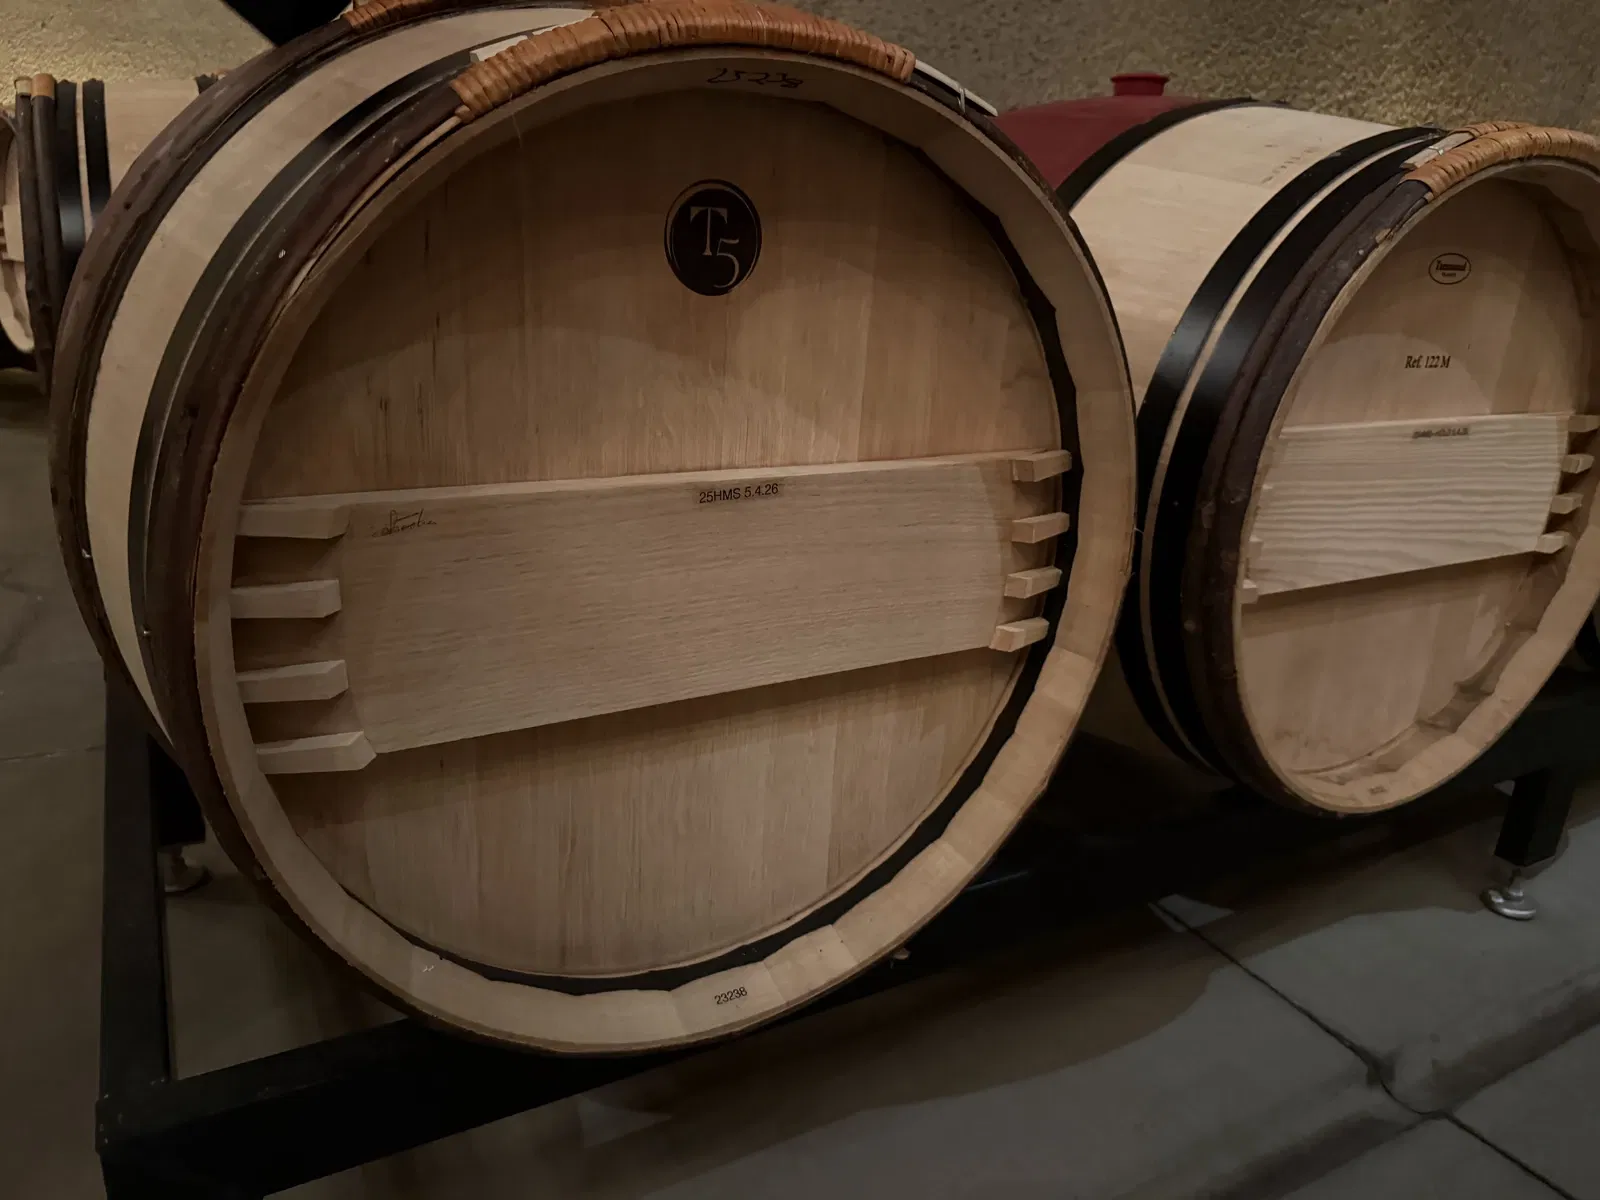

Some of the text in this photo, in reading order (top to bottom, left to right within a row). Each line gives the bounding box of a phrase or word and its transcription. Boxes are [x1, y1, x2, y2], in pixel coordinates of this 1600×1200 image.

[699, 482, 779, 504] 25HMS 5.4.26
[714, 986, 748, 1005] 23238
